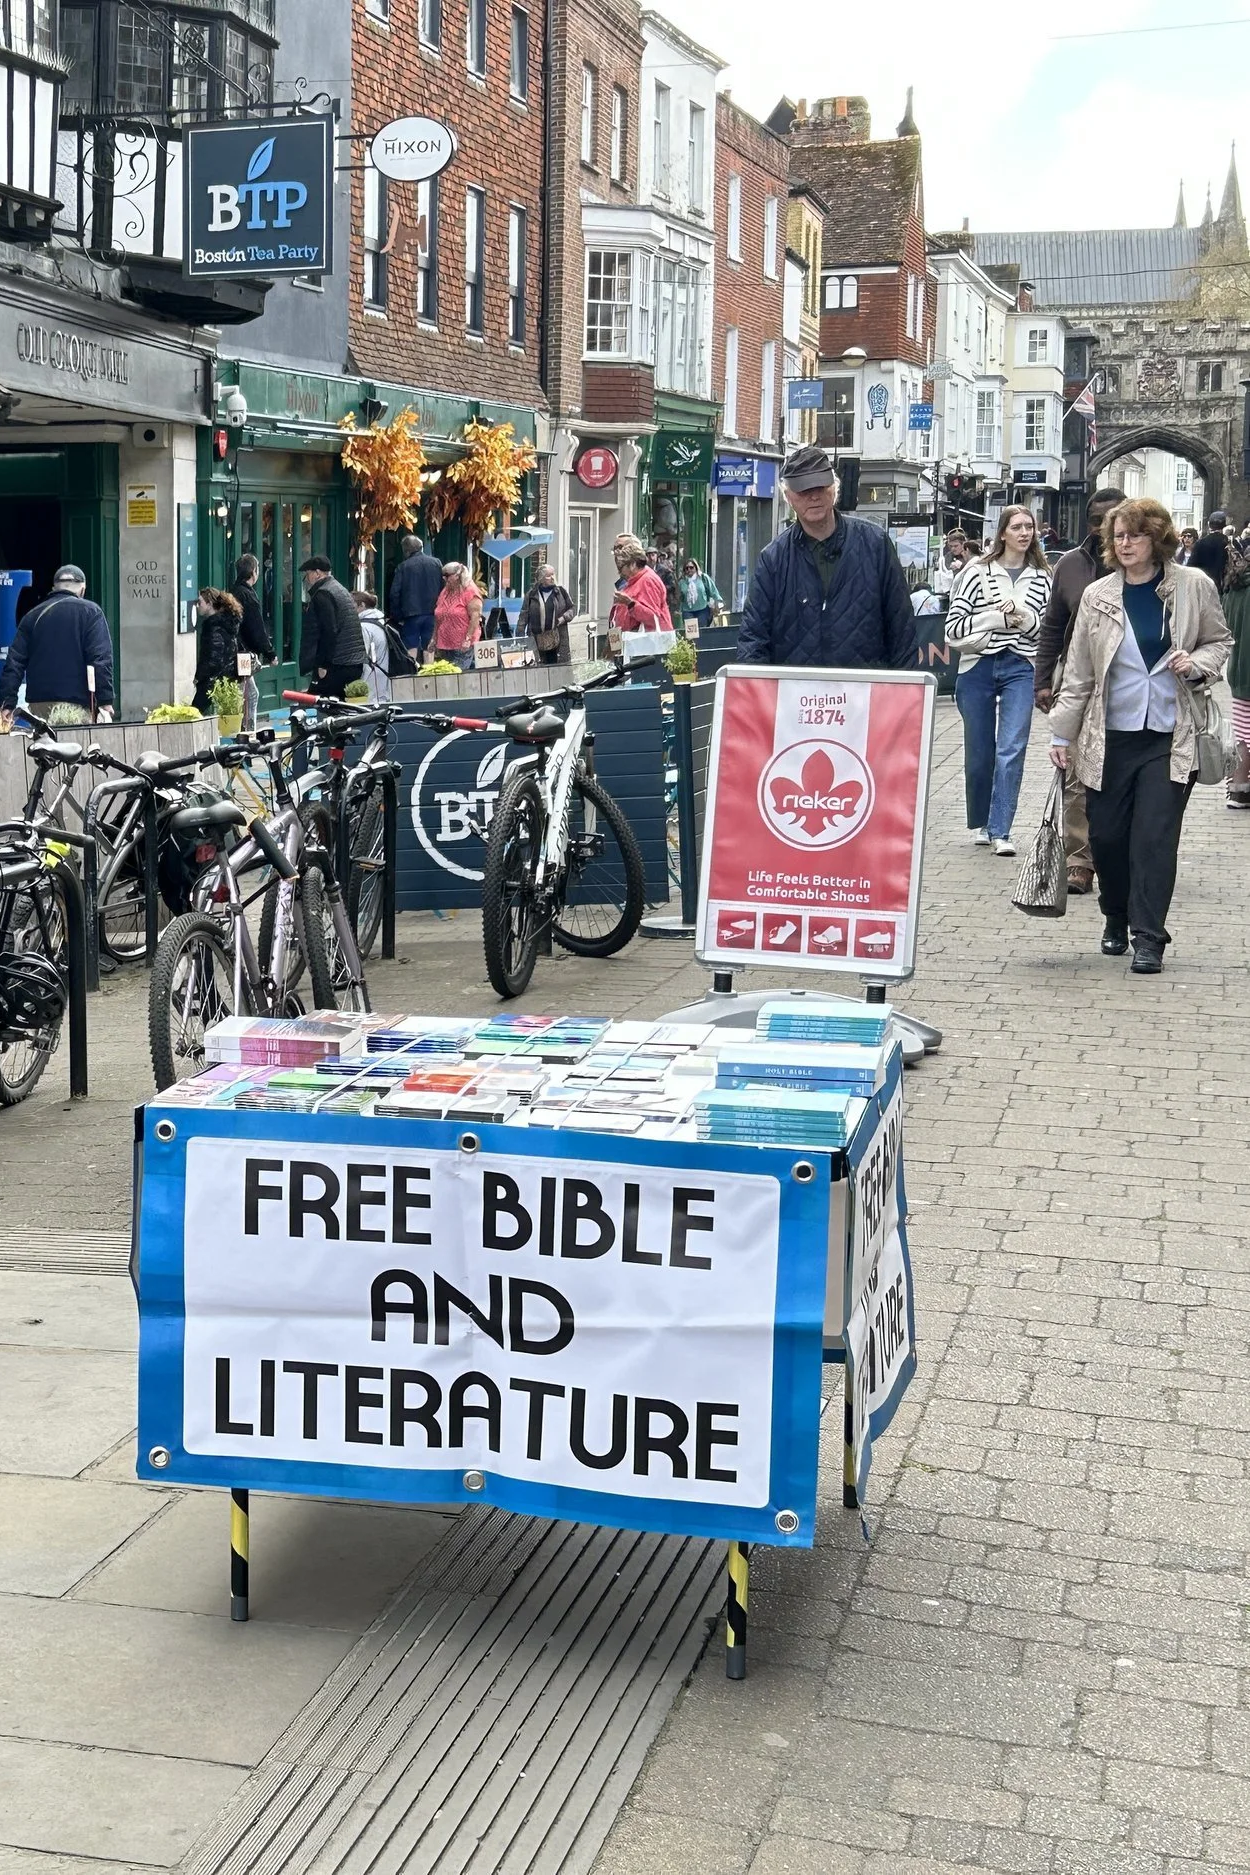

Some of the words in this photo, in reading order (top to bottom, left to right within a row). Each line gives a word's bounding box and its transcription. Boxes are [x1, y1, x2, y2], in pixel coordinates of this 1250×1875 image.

[383, 138, 441, 155] HIXON
[207, 181, 308, 232] BTP
[195, 248, 246, 264] Boston
[248, 246, 275, 261] Tea
[278, 244, 319, 262] Party
[719, 470, 752, 478] HALIFAX
[136, 561, 157, 571] OLD
[127, 575, 167, 585] GEORGE
[132, 588, 161, 599] MALL
[478, 648, 496, 660] 306
[800, 693, 847, 708] Original
[804, 709, 846, 726] 1874
[782, 791, 853, 811] rieker
[434, 791, 499, 842] BT
[748, 871, 773, 883] Life
[776, 873, 809, 885] Feels
[812, 875, 856, 888] Better
[859, 876, 871, 888] in
[746, 885, 827, 901] Comfortable
[830, 890, 870, 903] Shoes
[243, 1159, 432, 1246] FREE
[482, 1170, 716, 1271] BIBLE
[371, 1269, 576, 1356] AND
[214, 1357, 739, 1484] LITERATURE
